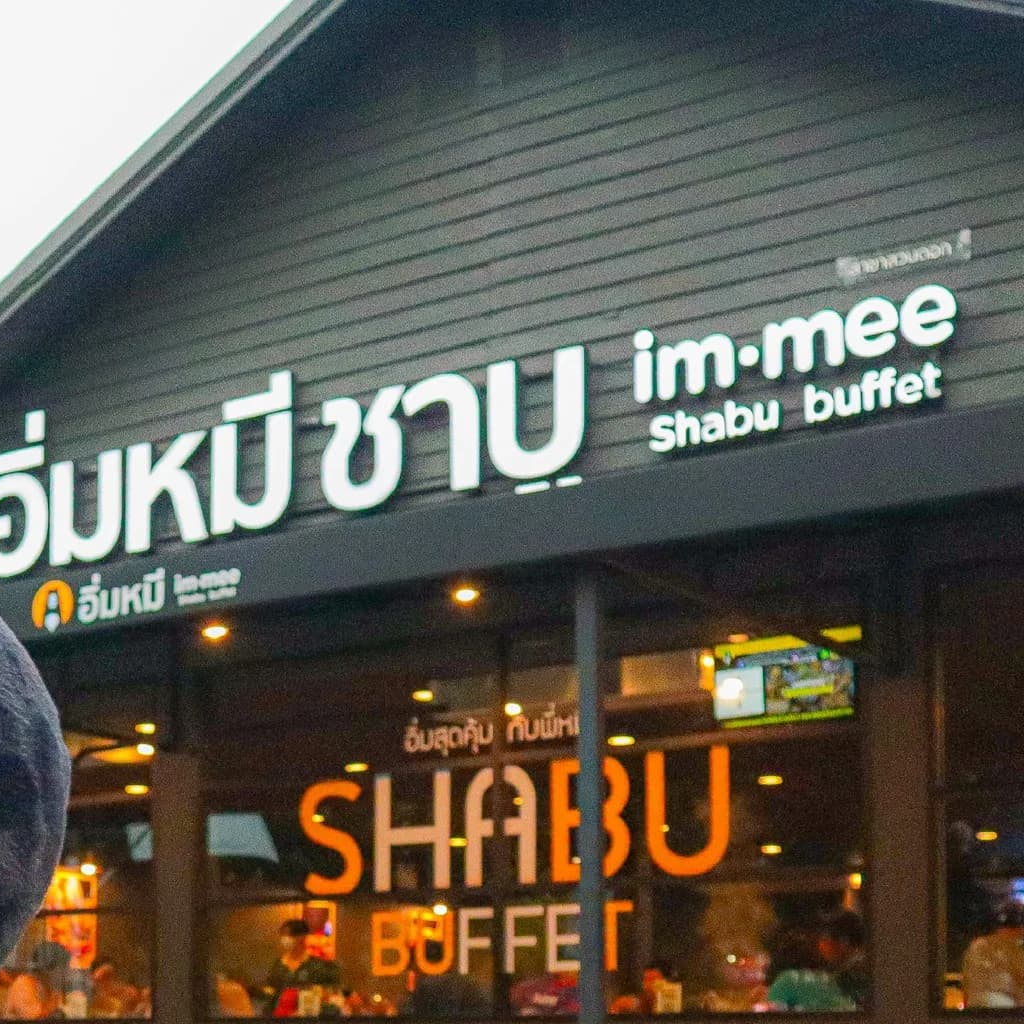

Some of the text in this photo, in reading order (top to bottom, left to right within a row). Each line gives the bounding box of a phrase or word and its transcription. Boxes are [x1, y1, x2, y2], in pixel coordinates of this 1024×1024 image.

[321, 345, 585, 495] ชาบ
[649, 362, 942, 453] Shabu buffet
[77, 567, 166, 624] อิ่มหมี
[299, 744, 732, 897] SHABU
[371, 898, 634, 978] BUFFET
